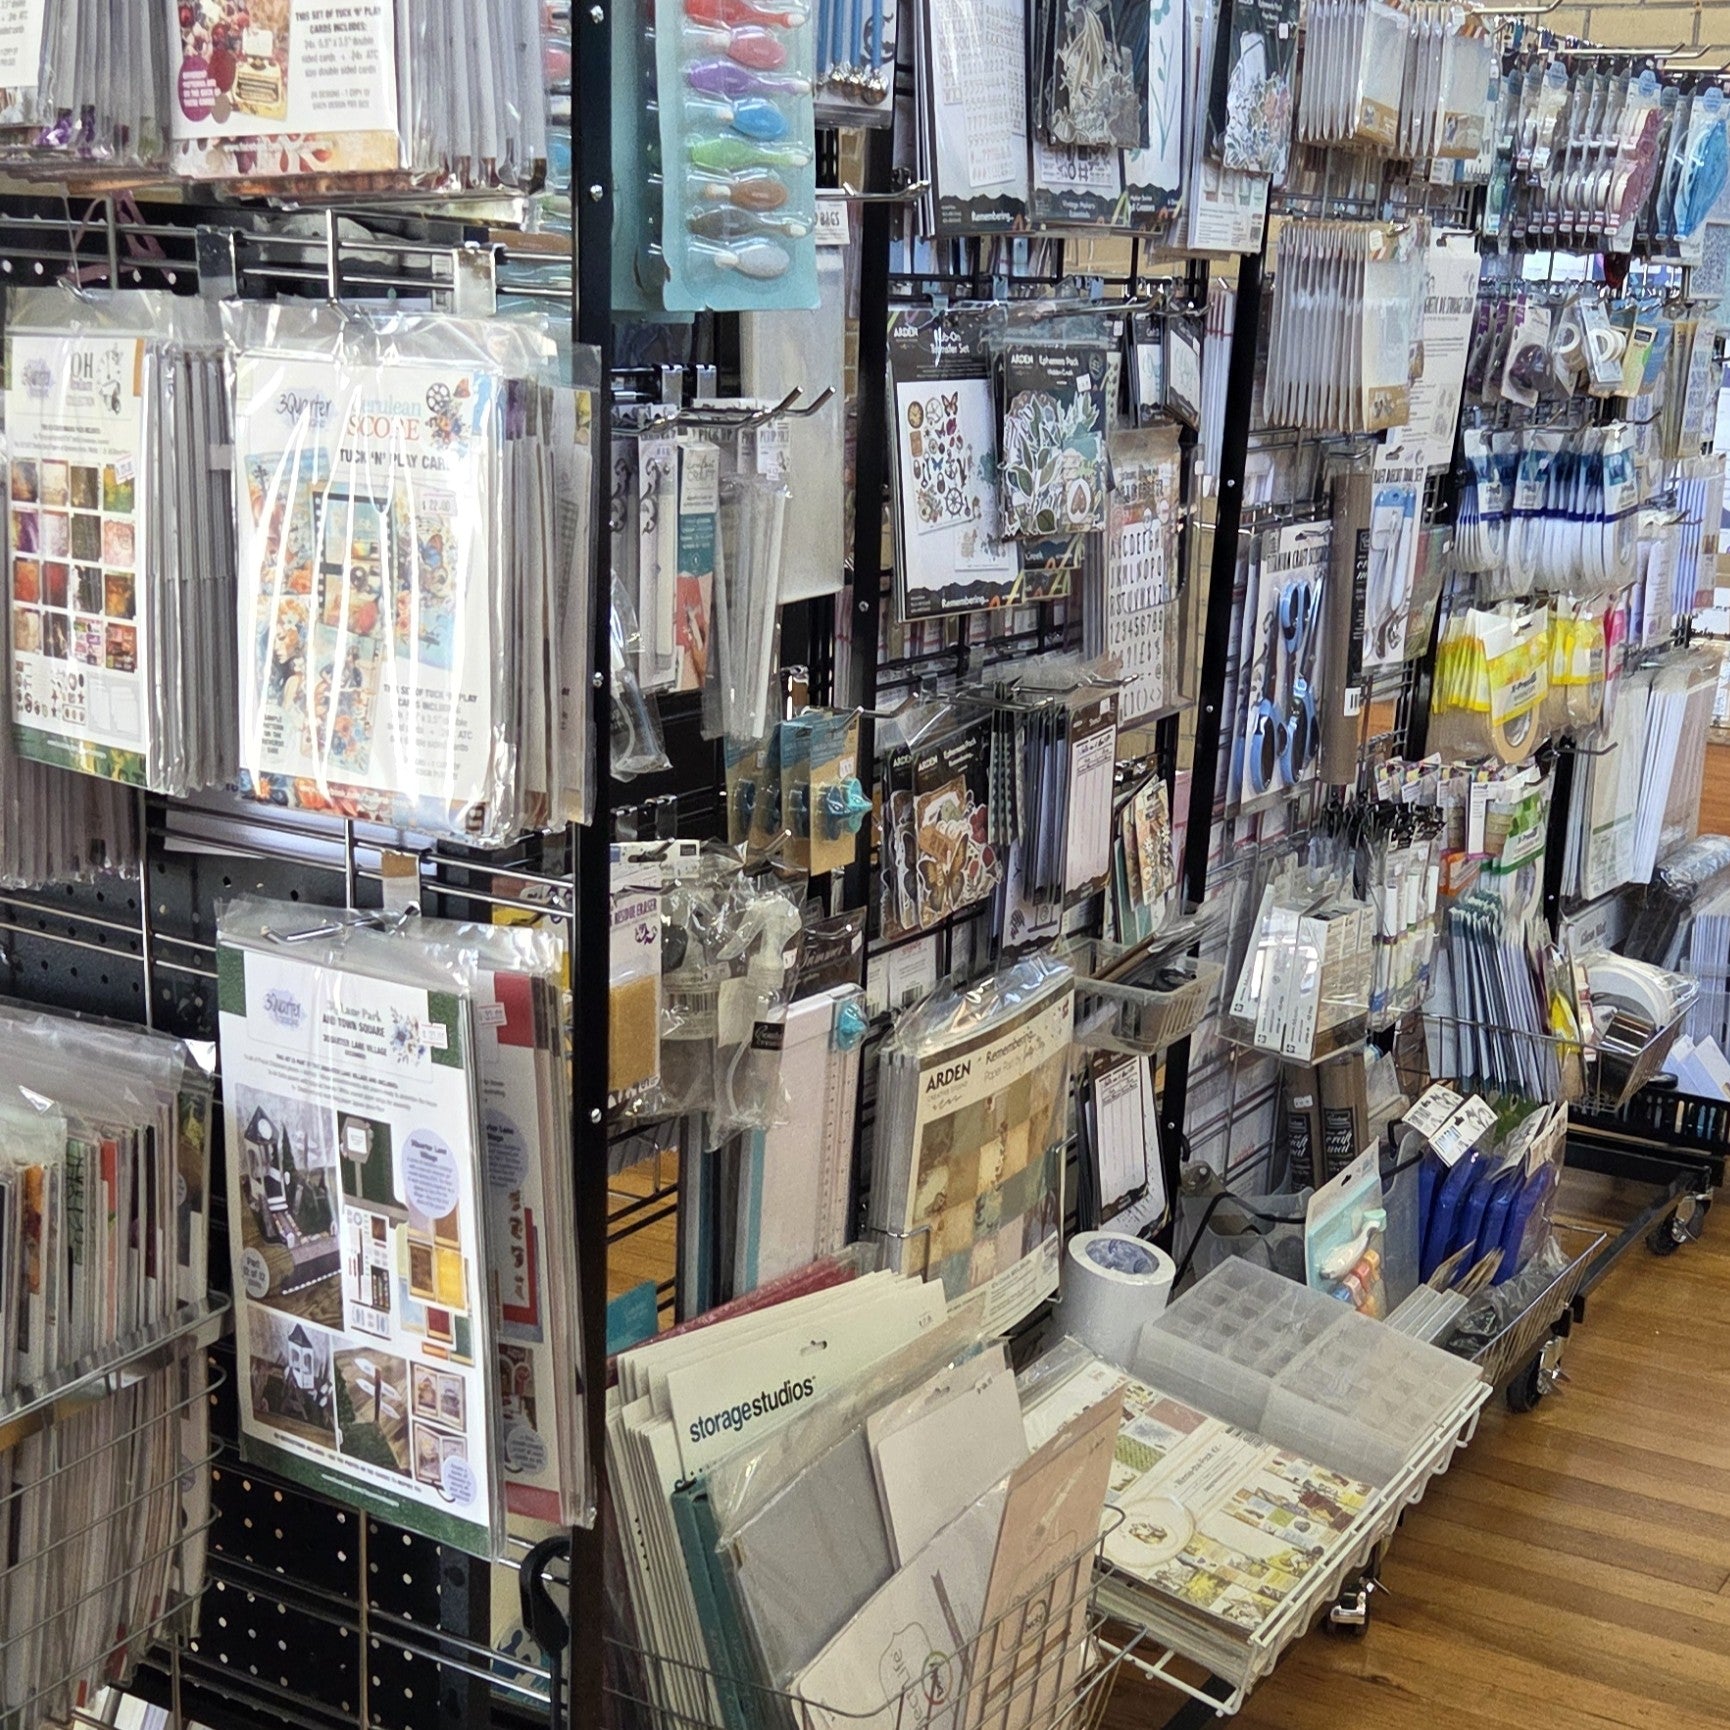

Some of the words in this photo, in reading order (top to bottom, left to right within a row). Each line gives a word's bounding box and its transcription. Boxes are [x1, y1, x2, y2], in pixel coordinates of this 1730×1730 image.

[309, 24, 331, 34] CARDS
[70, 352, 94, 379] OH
[926, 1060, 972, 1094] ARDEN
[689, 1375, 815, 1443] storagestudios
